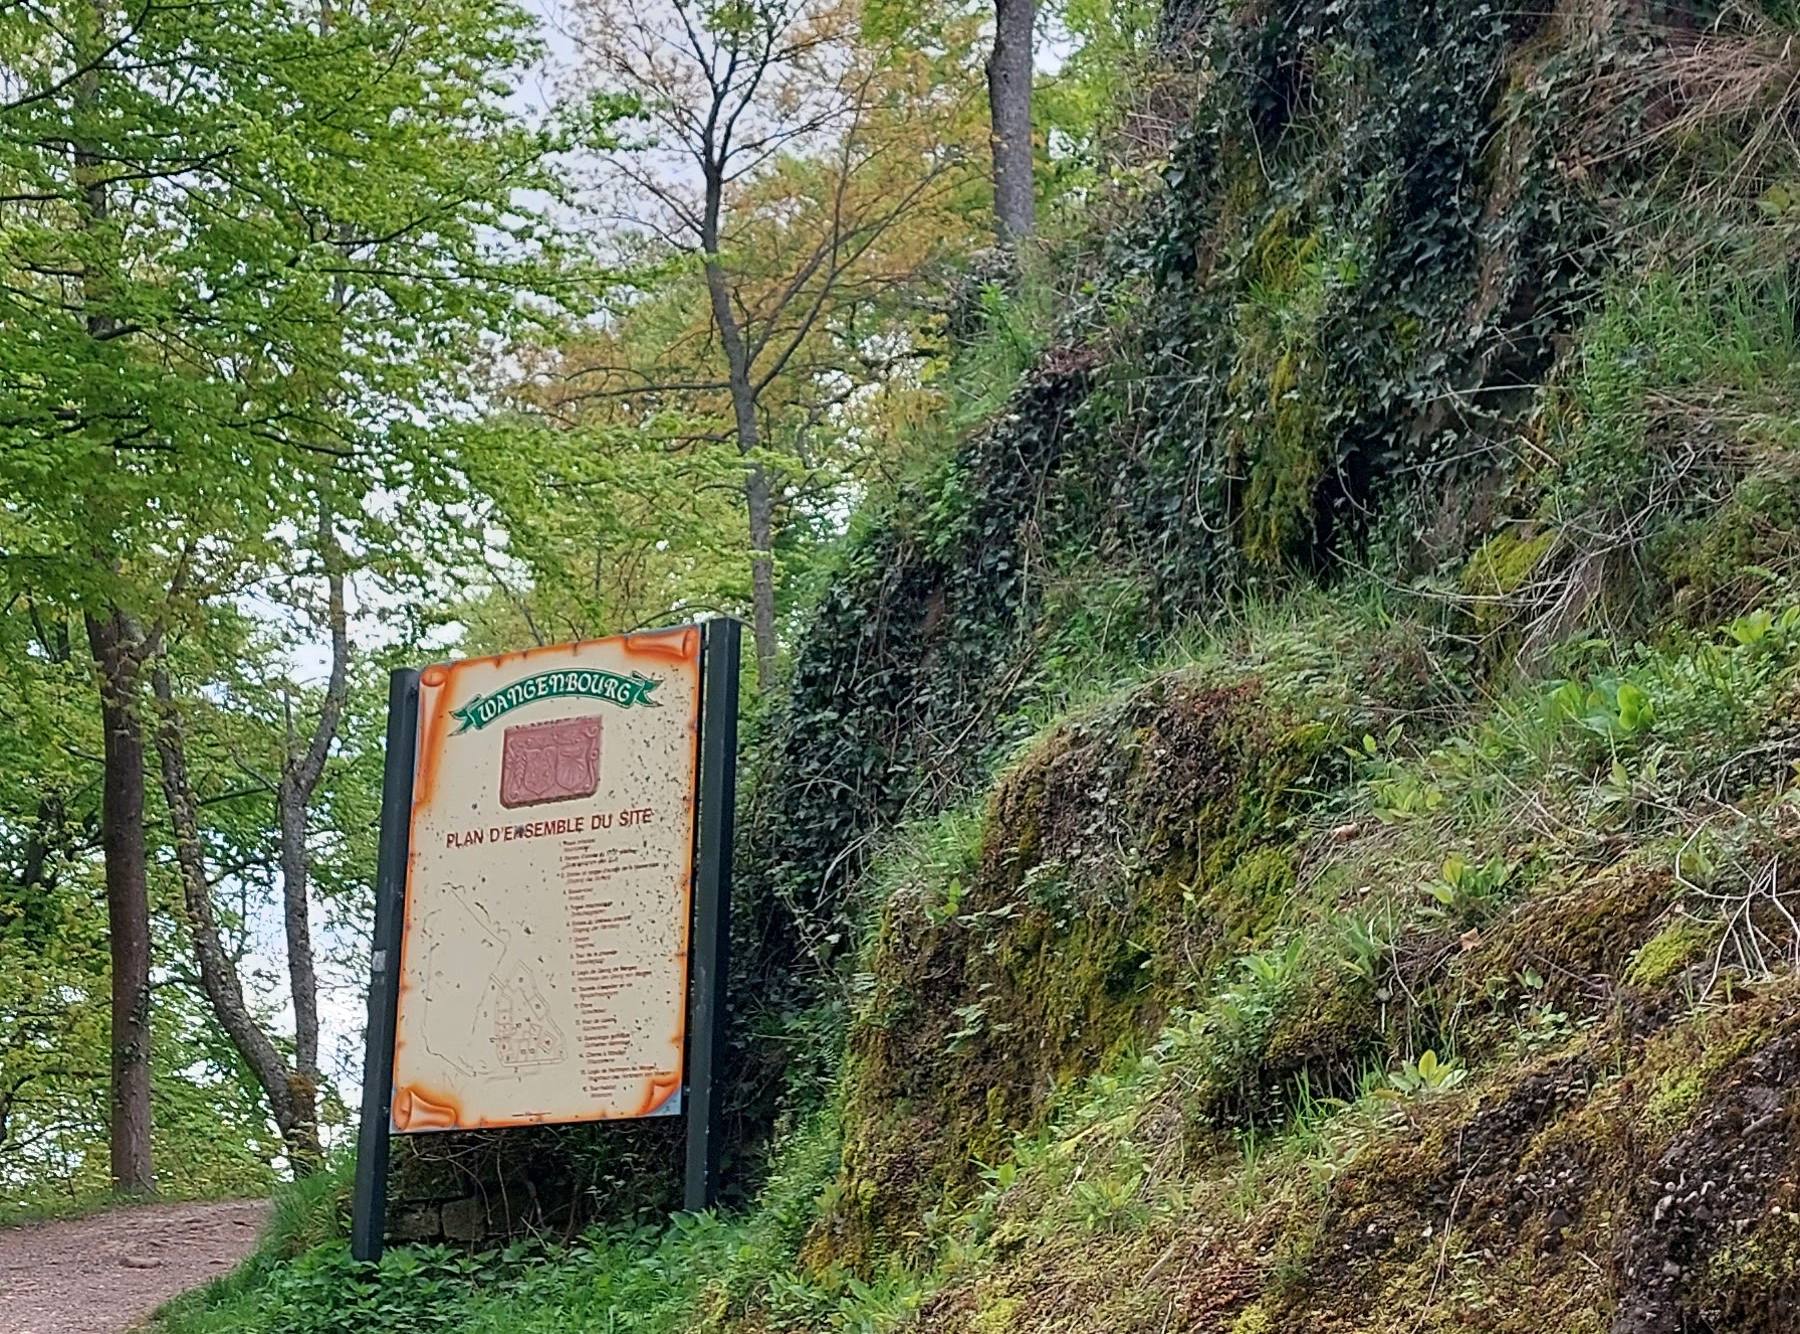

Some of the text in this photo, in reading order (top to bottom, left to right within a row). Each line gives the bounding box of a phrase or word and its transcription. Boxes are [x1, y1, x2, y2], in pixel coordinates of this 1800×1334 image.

[478, 672, 631, 721] WANGENBOURG
[446, 830, 484, 848] PLAN
[591, 813, 613, 830] DU
[619, 808, 653, 827] SITE
